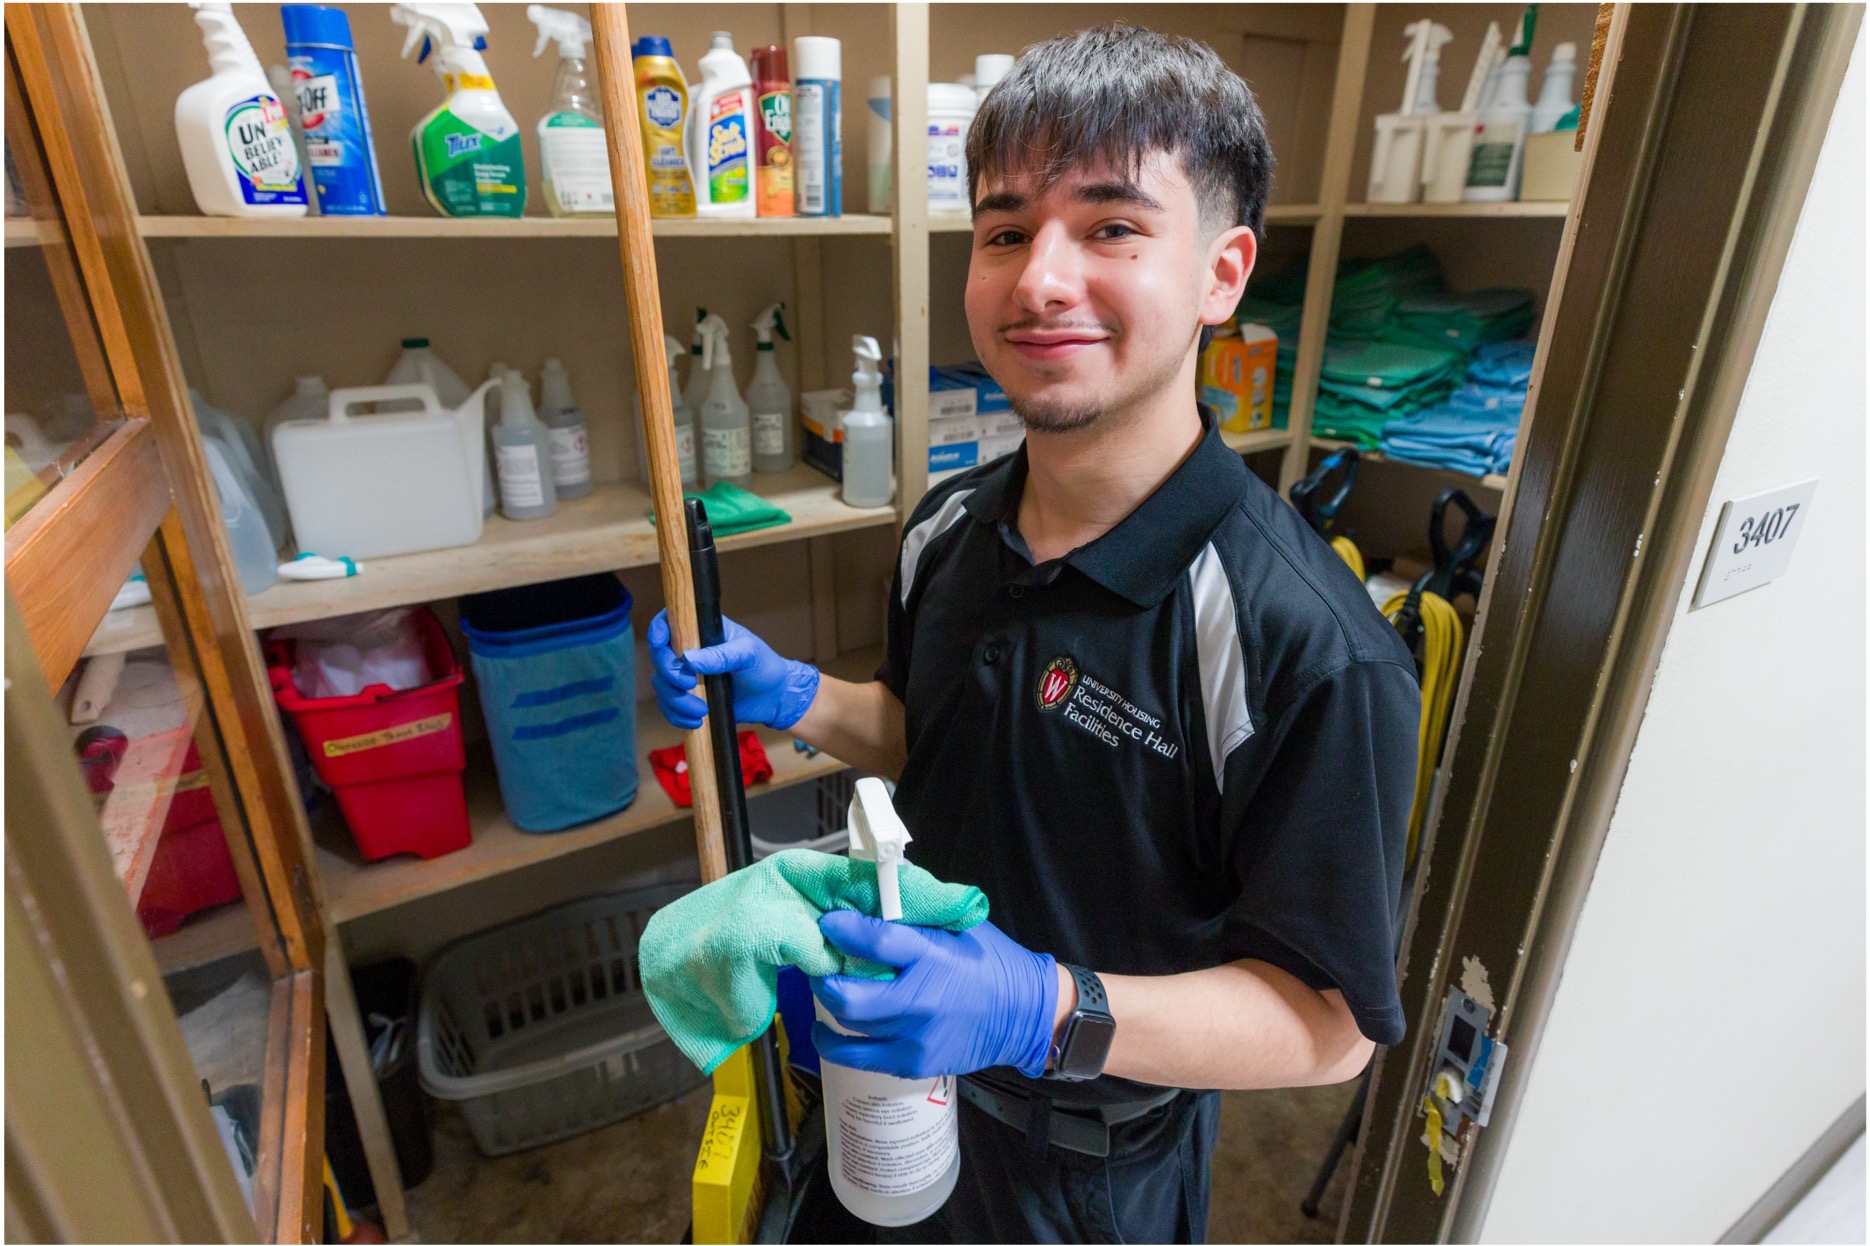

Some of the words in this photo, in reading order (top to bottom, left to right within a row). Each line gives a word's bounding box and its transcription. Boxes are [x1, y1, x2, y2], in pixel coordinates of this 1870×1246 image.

[1733, 503, 1801, 555] 3407
[1044, 673, 1068, 702] W
[1082, 674, 1124, 705] UNIVERSITY
[1122, 701, 1162, 730] HOUSING
[1063, 702, 1120, 748] Facilities
[1073, 685, 1143, 740] Residence
[1144, 731, 1179, 759] Hall
